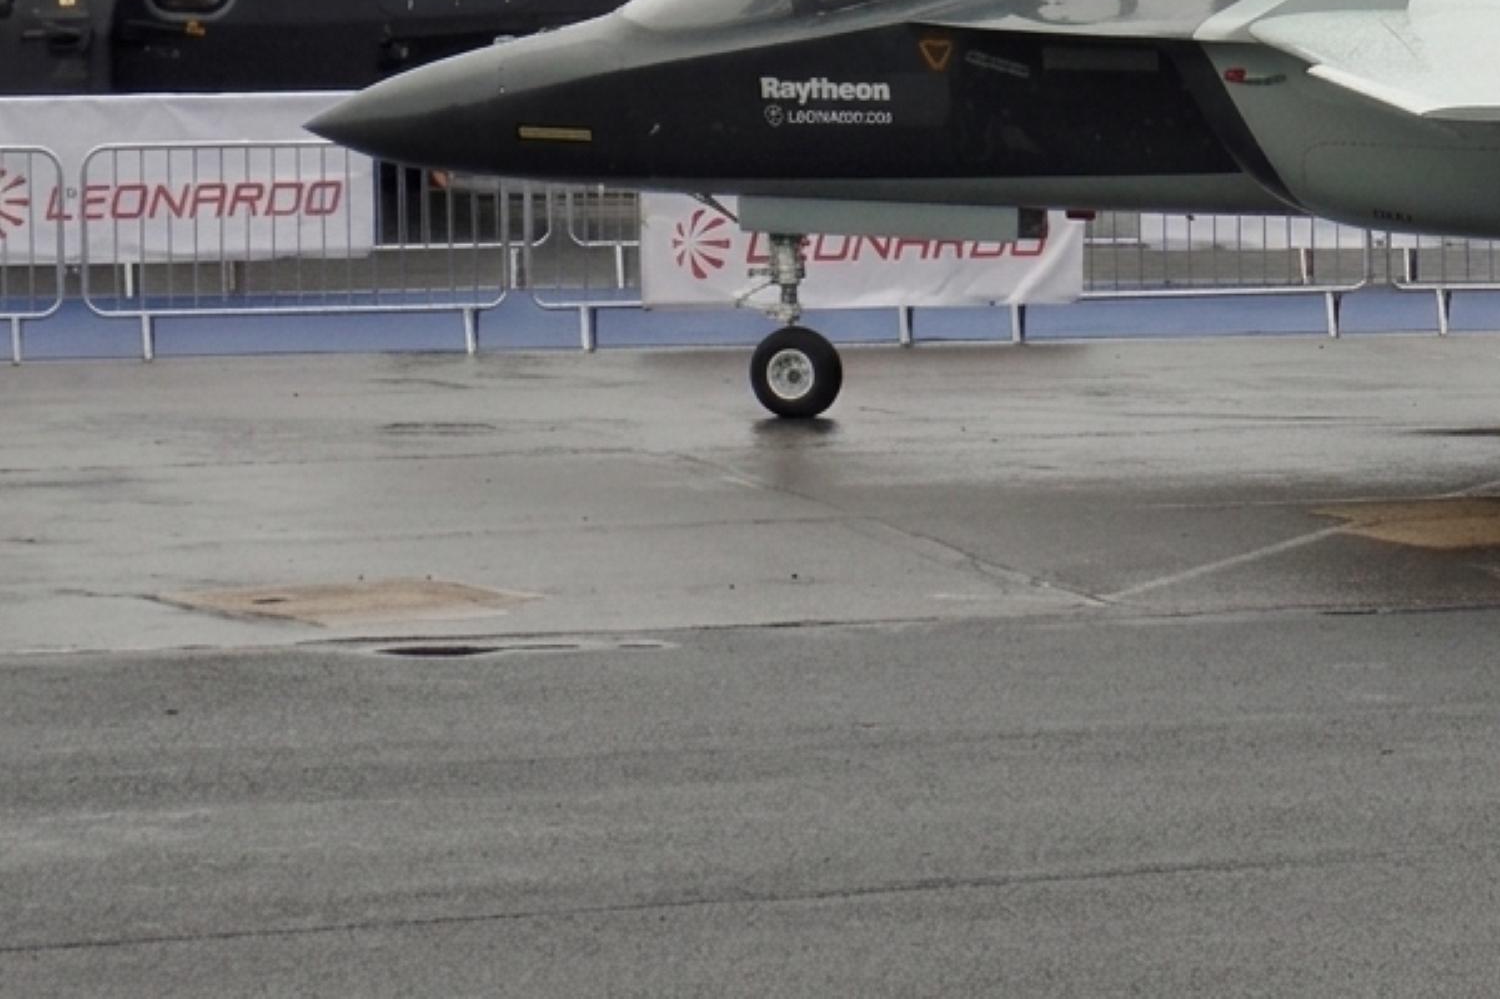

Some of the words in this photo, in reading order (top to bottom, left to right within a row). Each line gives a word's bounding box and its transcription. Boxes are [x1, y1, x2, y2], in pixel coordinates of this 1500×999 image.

[760, 76, 891, 105] Raytheon
[46, 180, 343, 221] LEONARDO
[746, 230, 1048, 262] LONARDO
